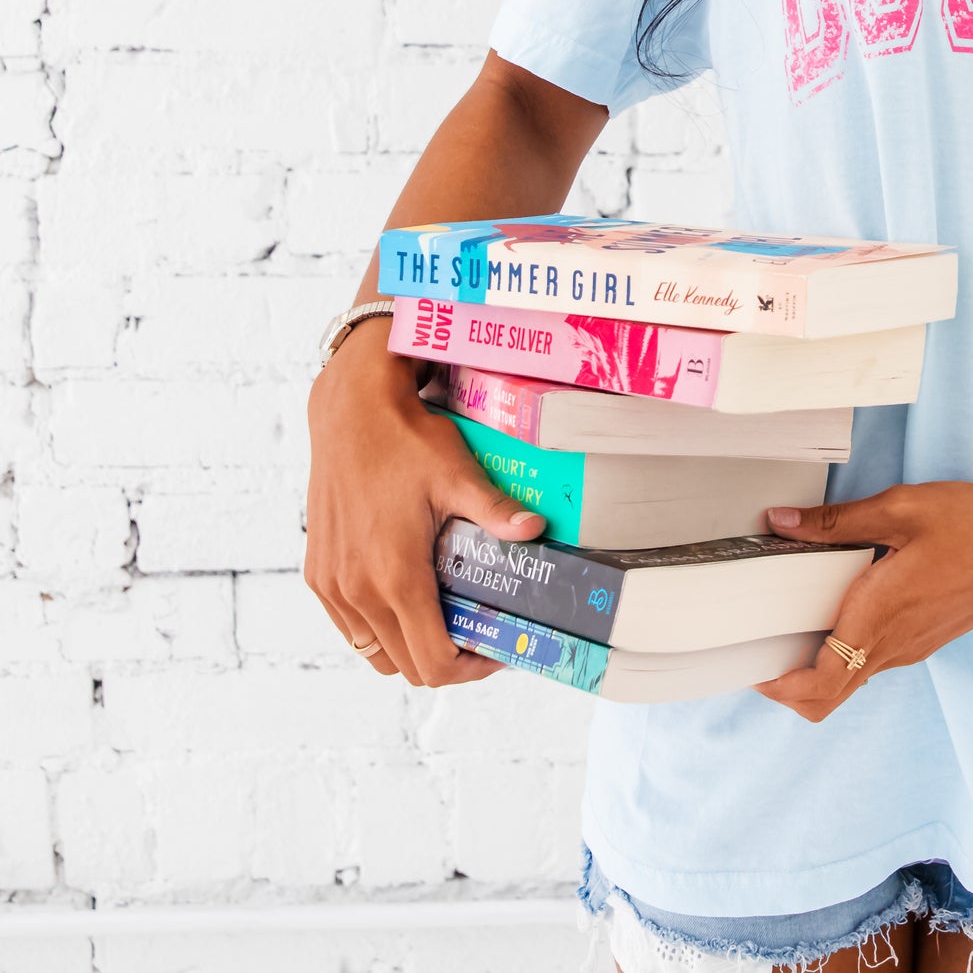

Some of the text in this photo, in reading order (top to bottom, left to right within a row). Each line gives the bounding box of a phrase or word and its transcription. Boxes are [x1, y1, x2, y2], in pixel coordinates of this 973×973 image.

[397, 250, 635, 306] THE SUMMER GIRL
[653, 281, 744, 316] Elle Kennedy
[412, 298, 434, 347] WILD
[431, 302, 454, 351] LOVE
[468, 319, 553, 355] ELSIE SILVER
[466, 377, 488, 412] Lake
[483, 452, 527, 479] COURT
[510, 482, 544, 506] FURY
[436, 555, 522, 597] BROADBENT
[452, 533, 498, 566] WINGS
[505, 542, 556, 585] NIGHT
[452, 614, 500, 640] LYLA SAGE
